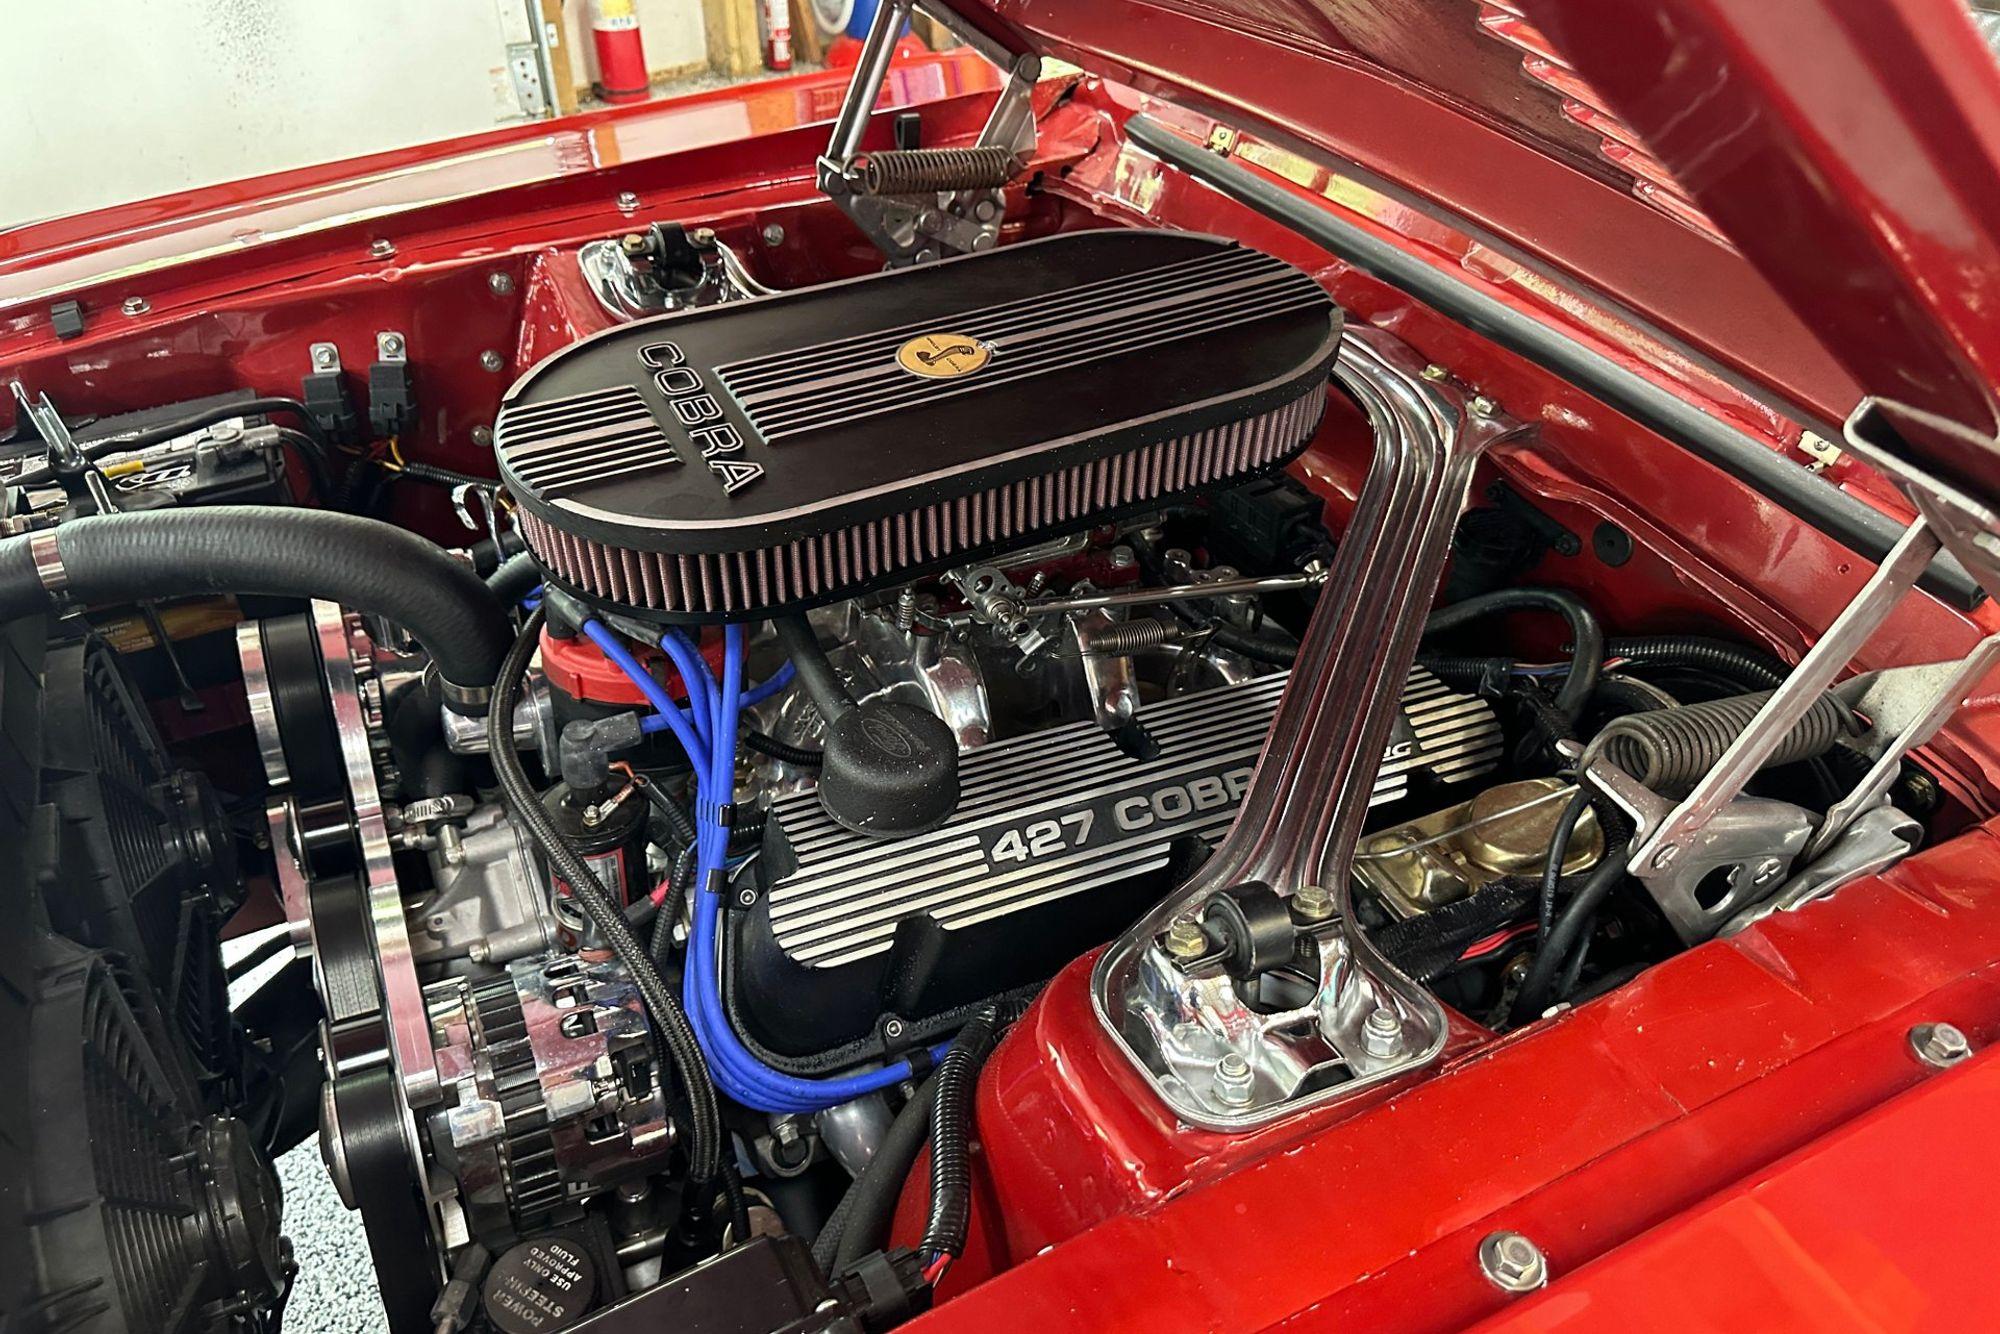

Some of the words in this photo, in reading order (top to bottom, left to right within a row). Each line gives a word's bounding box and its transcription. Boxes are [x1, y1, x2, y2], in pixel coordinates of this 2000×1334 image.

[637, 341, 765, 496] COBRA
[991, 809, 1095, 863] 427
[523, 1258, 551, 1277] ONLY
[530, 1247, 583, 1282] APPROVED
[550, 1245, 580, 1266] FLUID
[550, 1273, 572, 1291] USE
[493, 1289, 544, 1328] POWER
